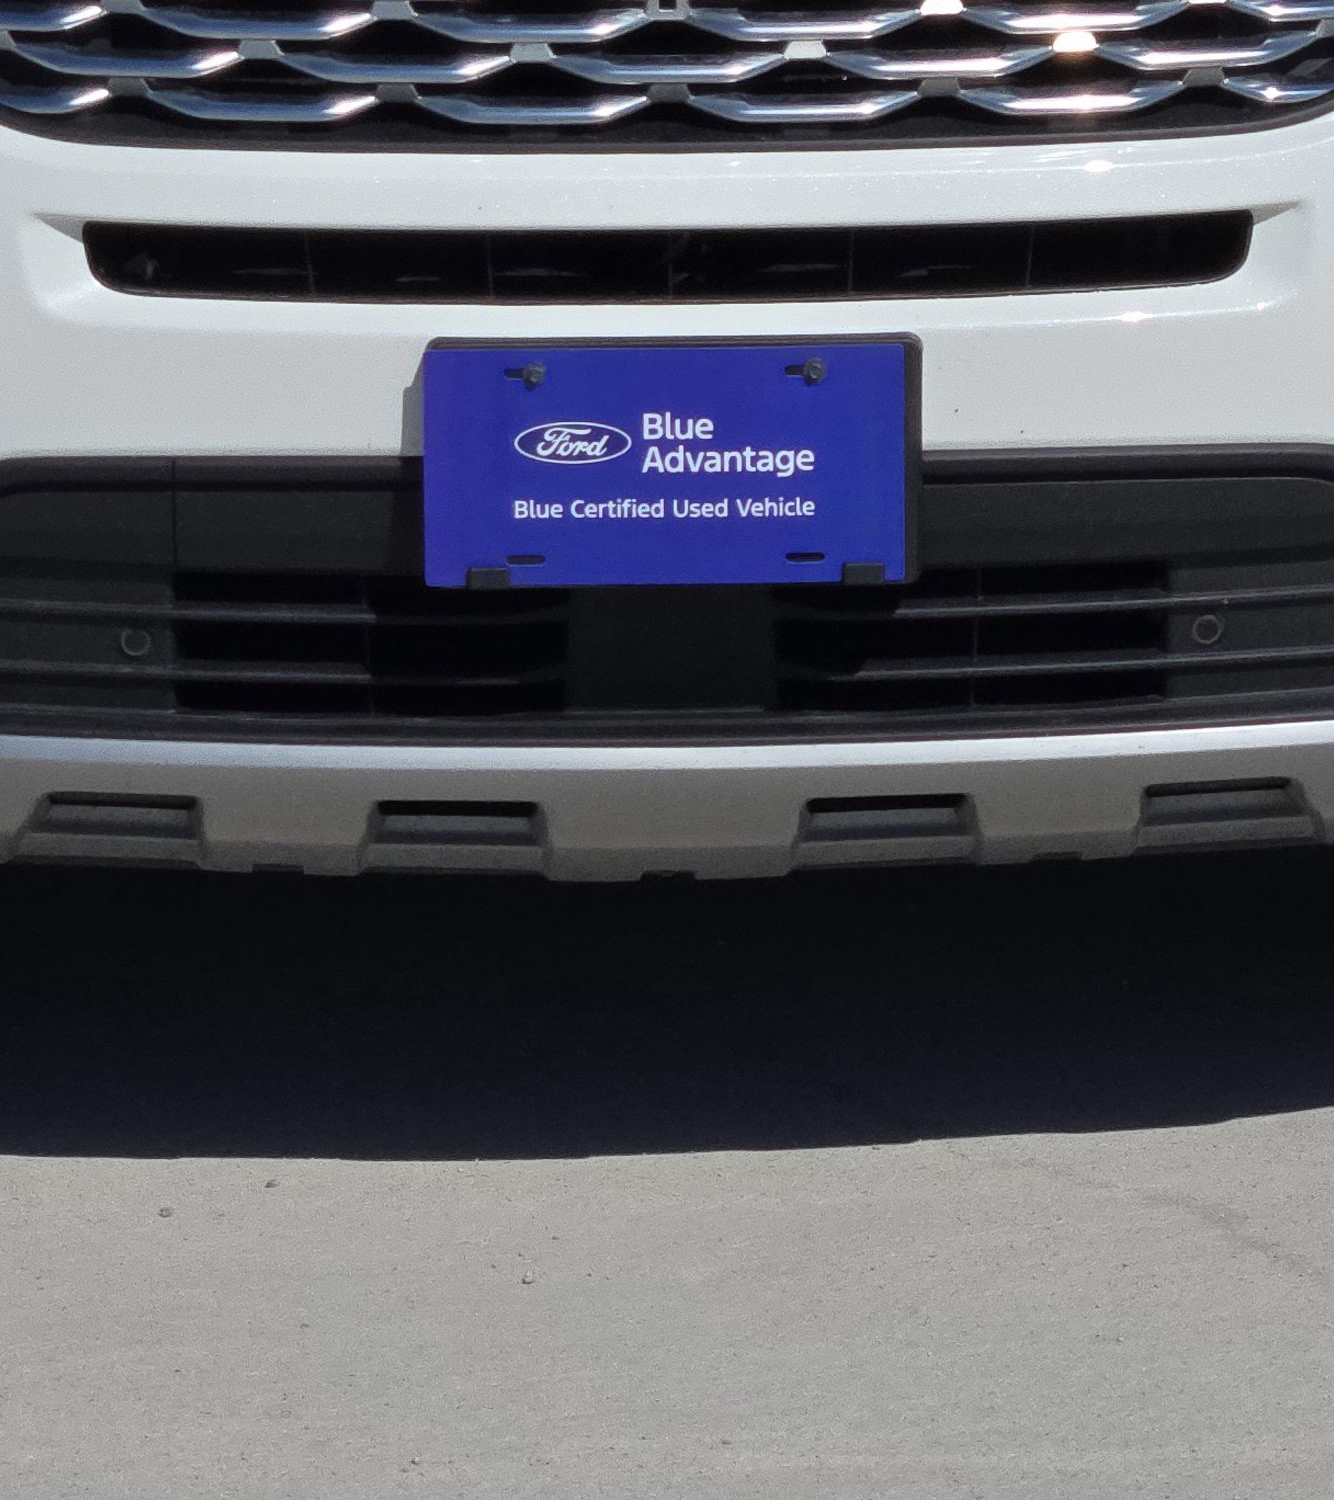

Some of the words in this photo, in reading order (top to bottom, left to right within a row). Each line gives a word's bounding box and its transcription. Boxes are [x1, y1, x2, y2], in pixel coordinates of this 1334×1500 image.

[642, 412, 714, 440] Blue
[536, 426, 610, 458] Ford
[641, 444, 815, 478] Advantage
[513, 499, 564, 519] Blue
[569, 498, 665, 519] Certified
[672, 498, 729, 518] Used
[735, 496, 815, 518] Vehicle
